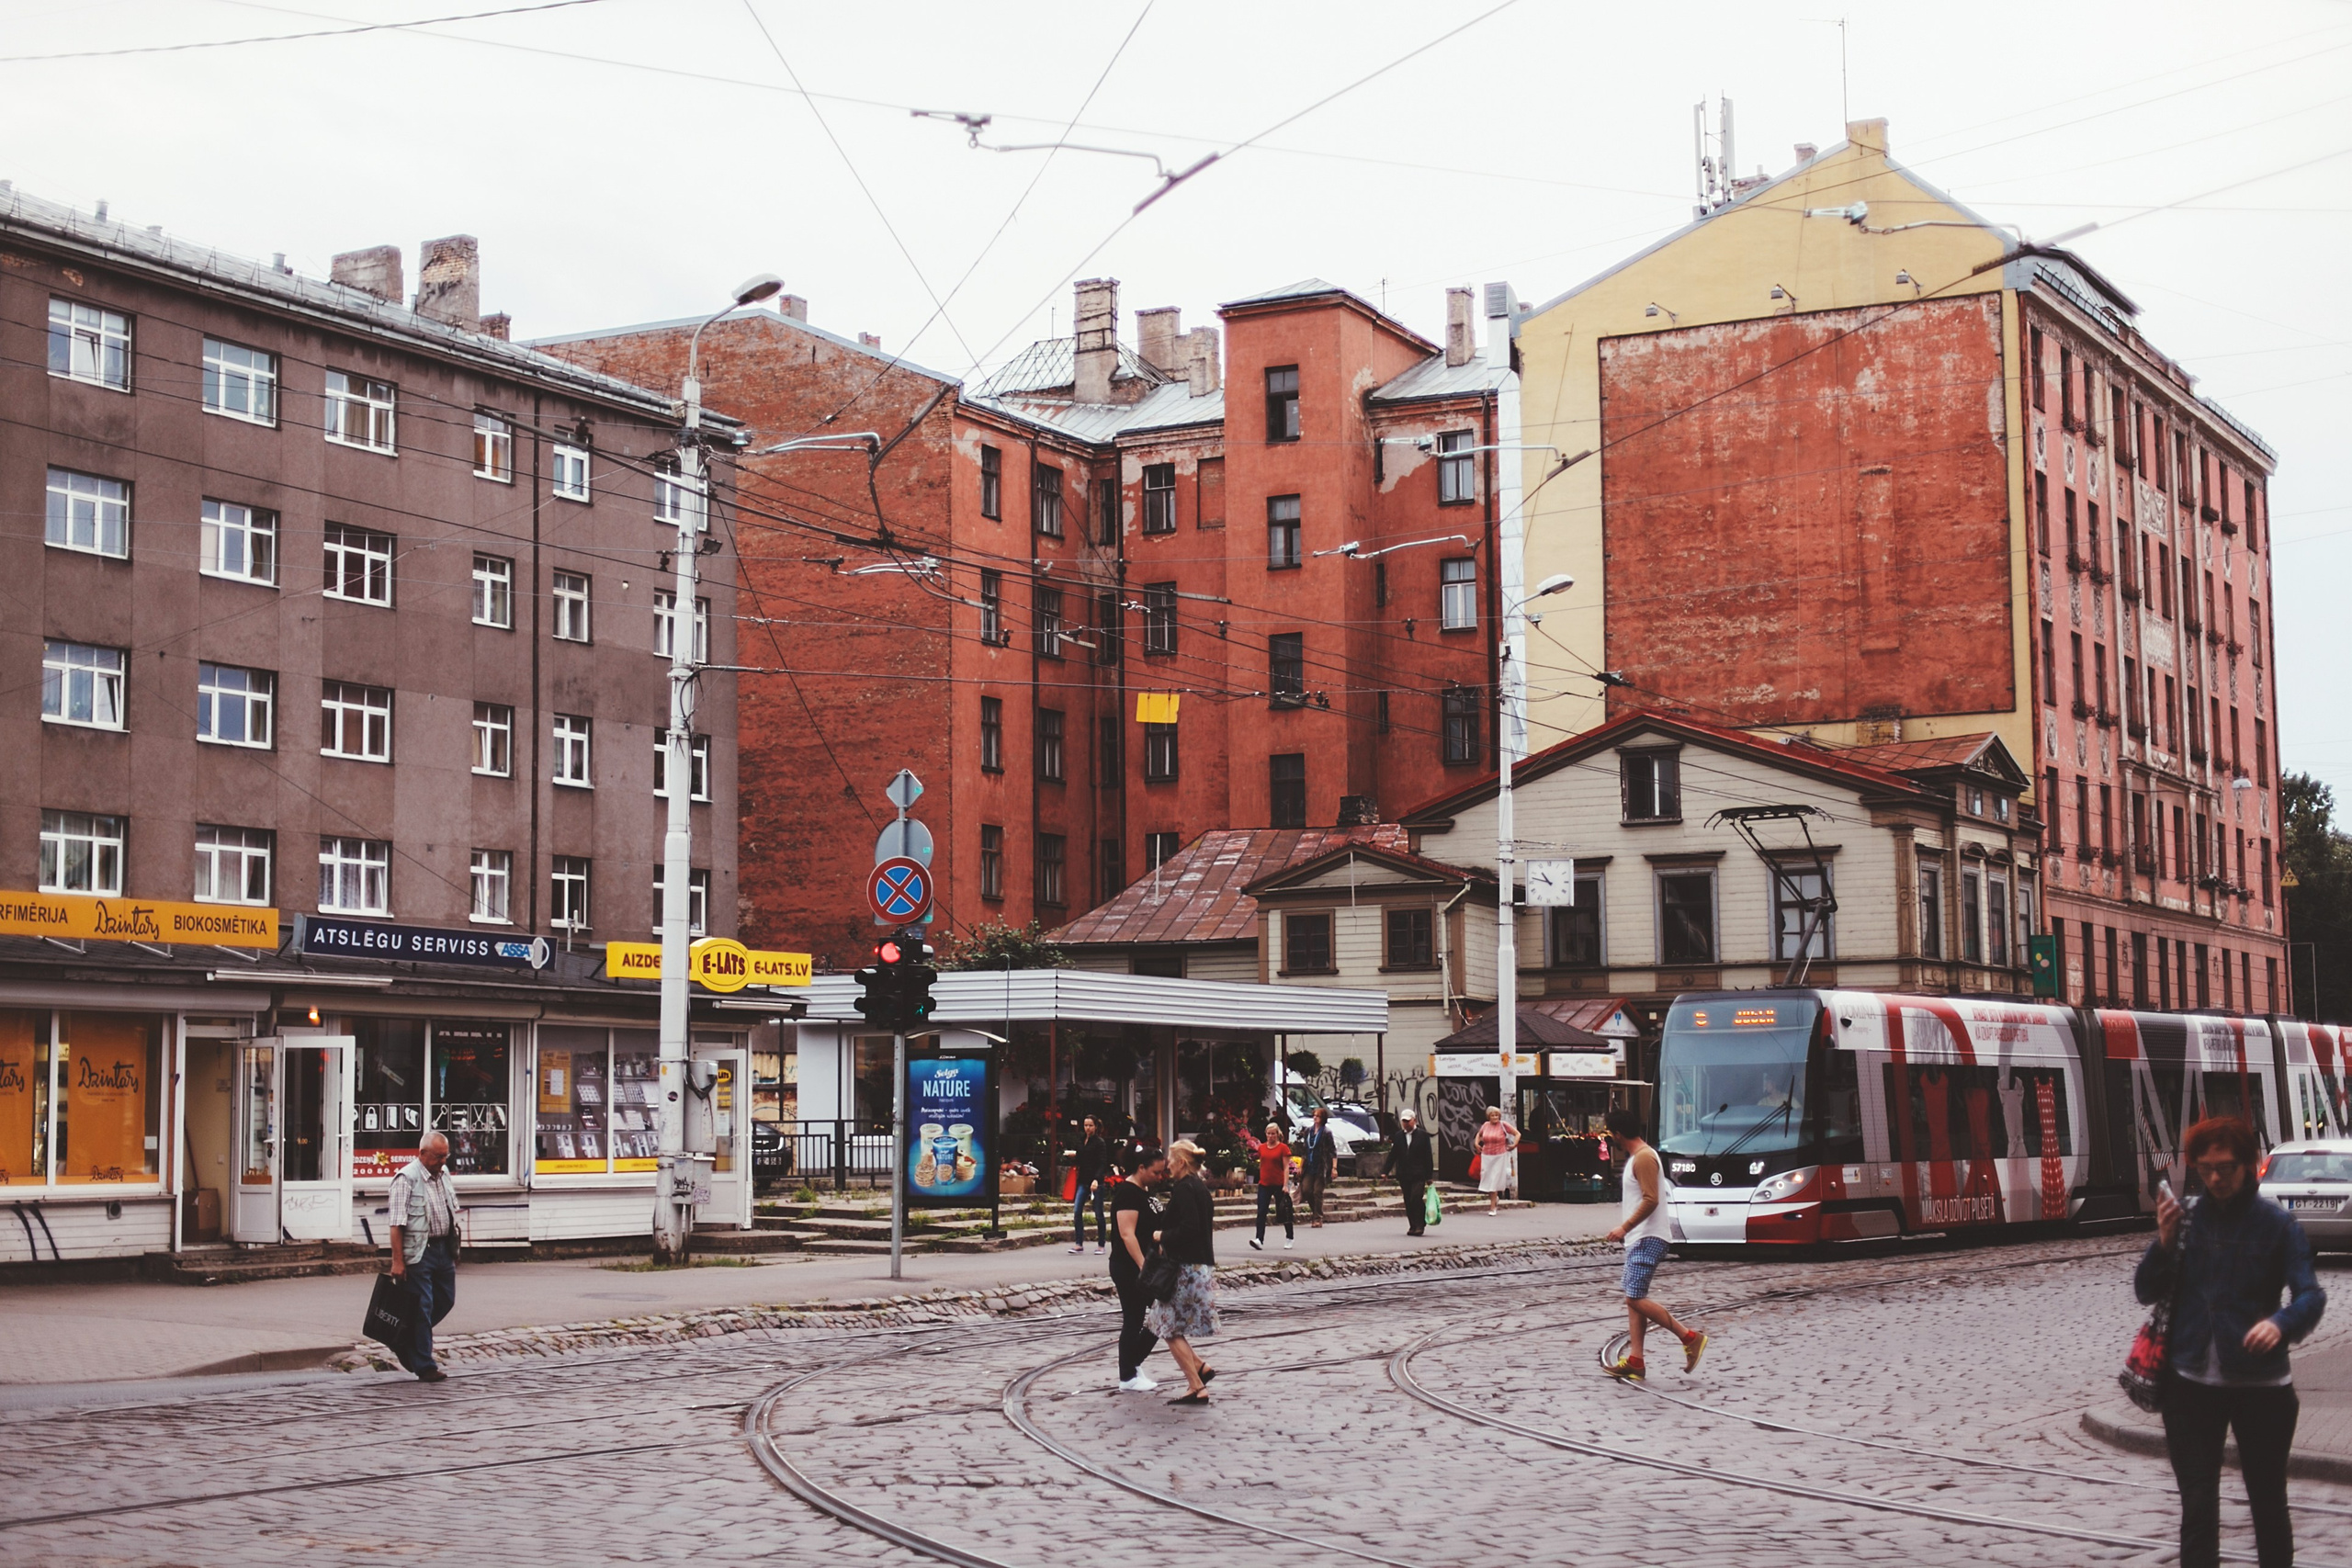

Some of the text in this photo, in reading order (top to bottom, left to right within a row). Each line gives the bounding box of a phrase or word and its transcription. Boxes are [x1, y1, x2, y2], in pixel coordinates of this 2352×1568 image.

[174, 915, 267, 935] BIOKOSMĒTIKA
[313, 928, 489, 956] ATSLĒGU SERVISS
[501, 942, 531, 958] ASSA
[703, 952, 746, 976] E-LATS
[754, 960, 808, 977] E-LATS.LV
[922, 1079, 971, 1098] NATURE
[1671, 1162, 1696, 1173] 57180
[374, 1306, 400, 1327] LIBERTY
